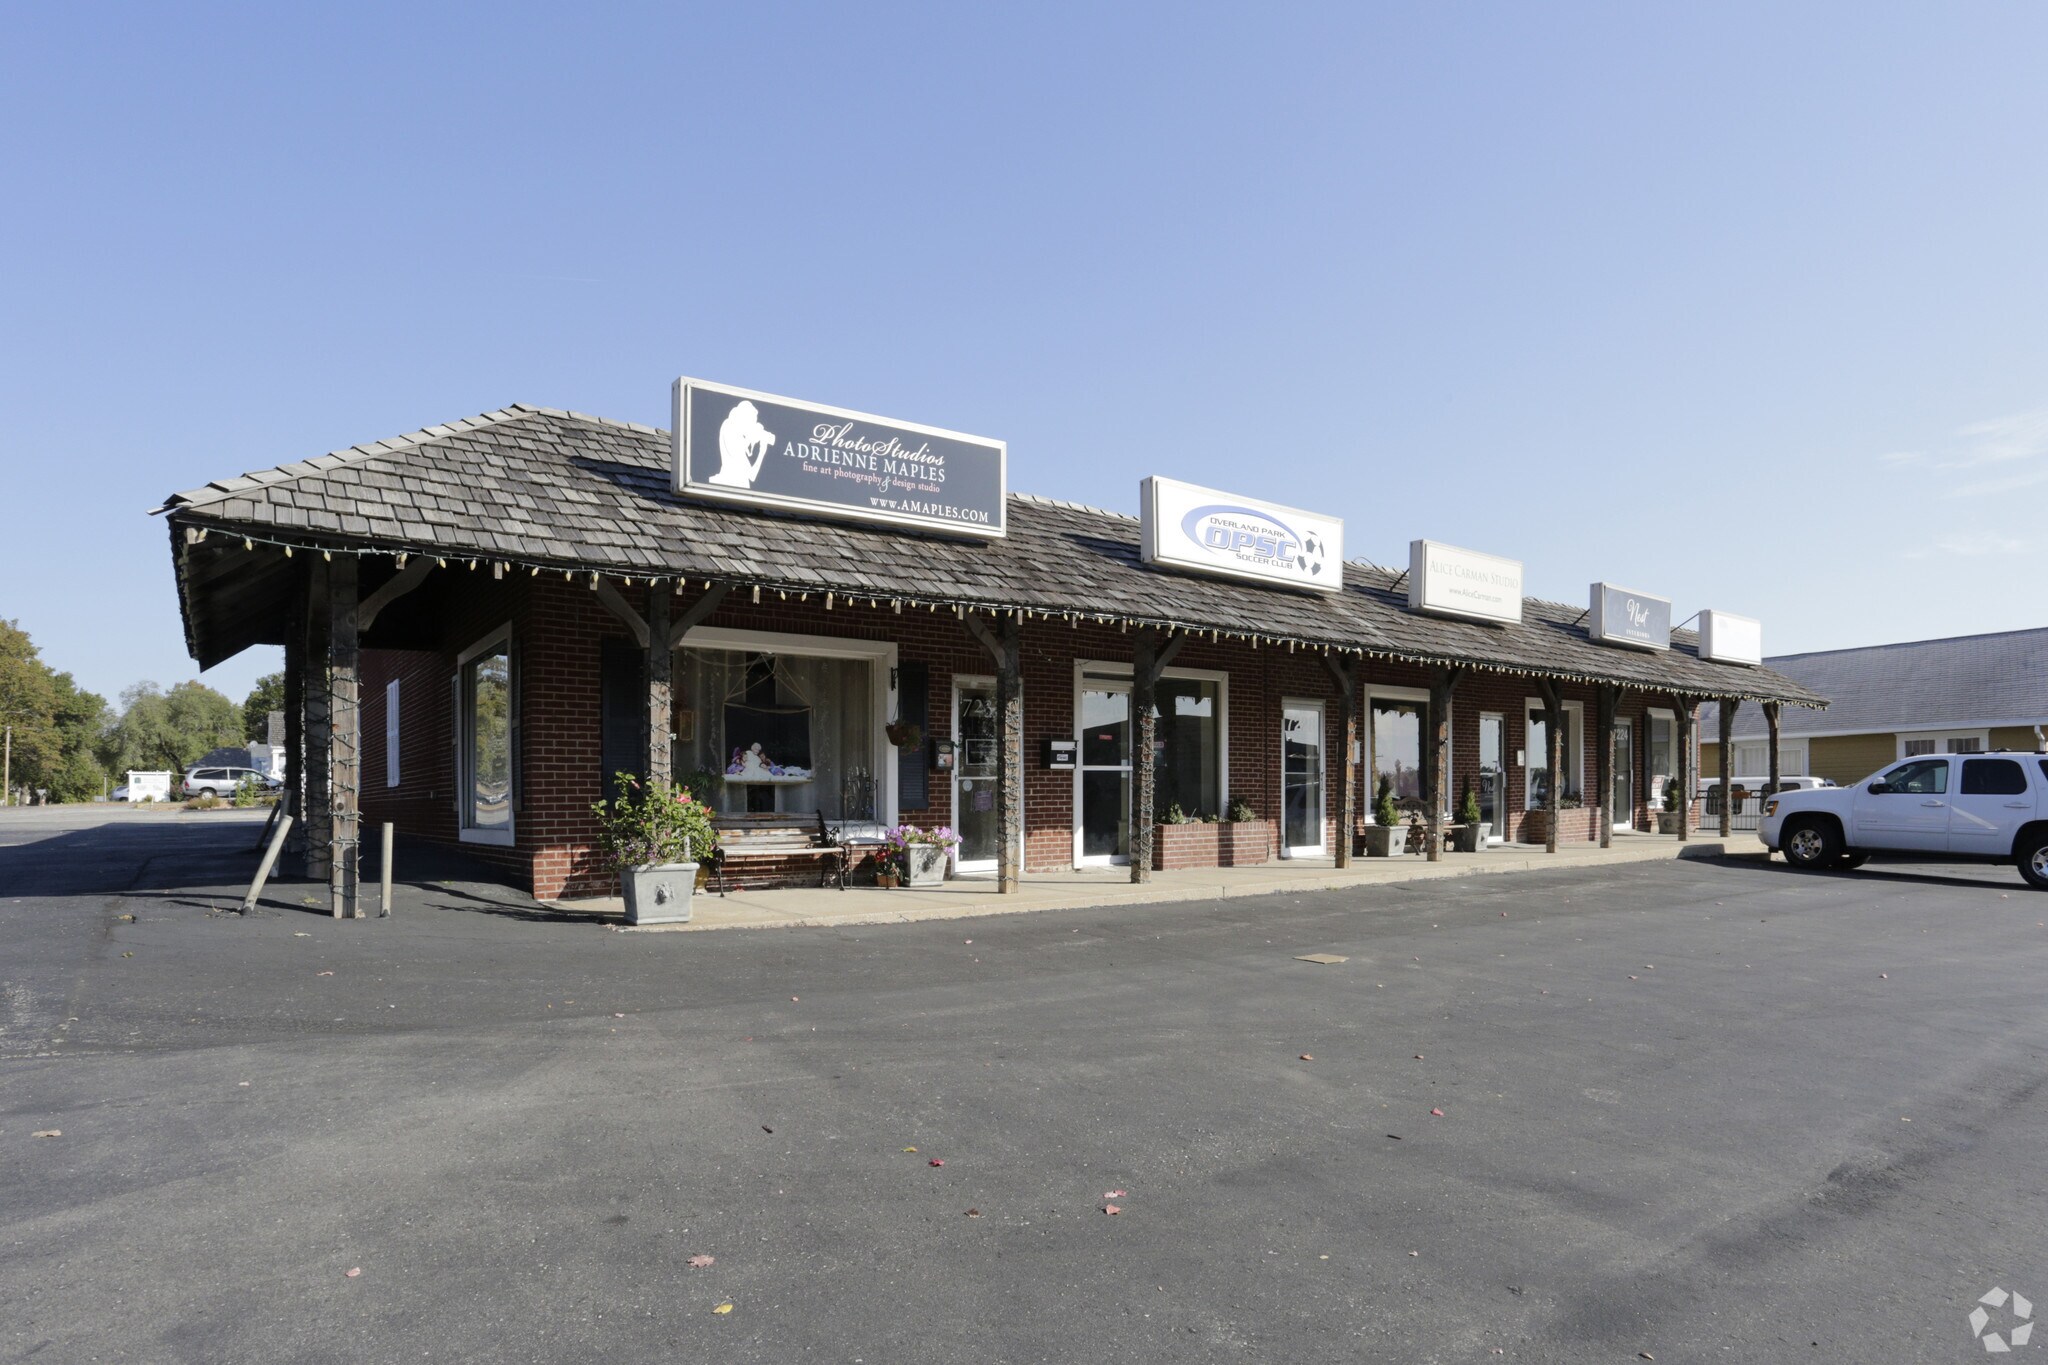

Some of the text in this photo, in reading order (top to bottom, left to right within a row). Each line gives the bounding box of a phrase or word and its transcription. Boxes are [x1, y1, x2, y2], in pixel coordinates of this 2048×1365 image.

[783, 441, 945, 483] ADRIENNE MAPLES
[803, 461, 940, 493] fine art photography & design studio
[870, 497, 988, 523] www.AMAPLES.COM
[1210, 517, 1285, 538] OVERLAND PARK
[1204, 526, 1297, 562] OPSC
[1236, 552, 1293, 569] SOCCER CLUB
